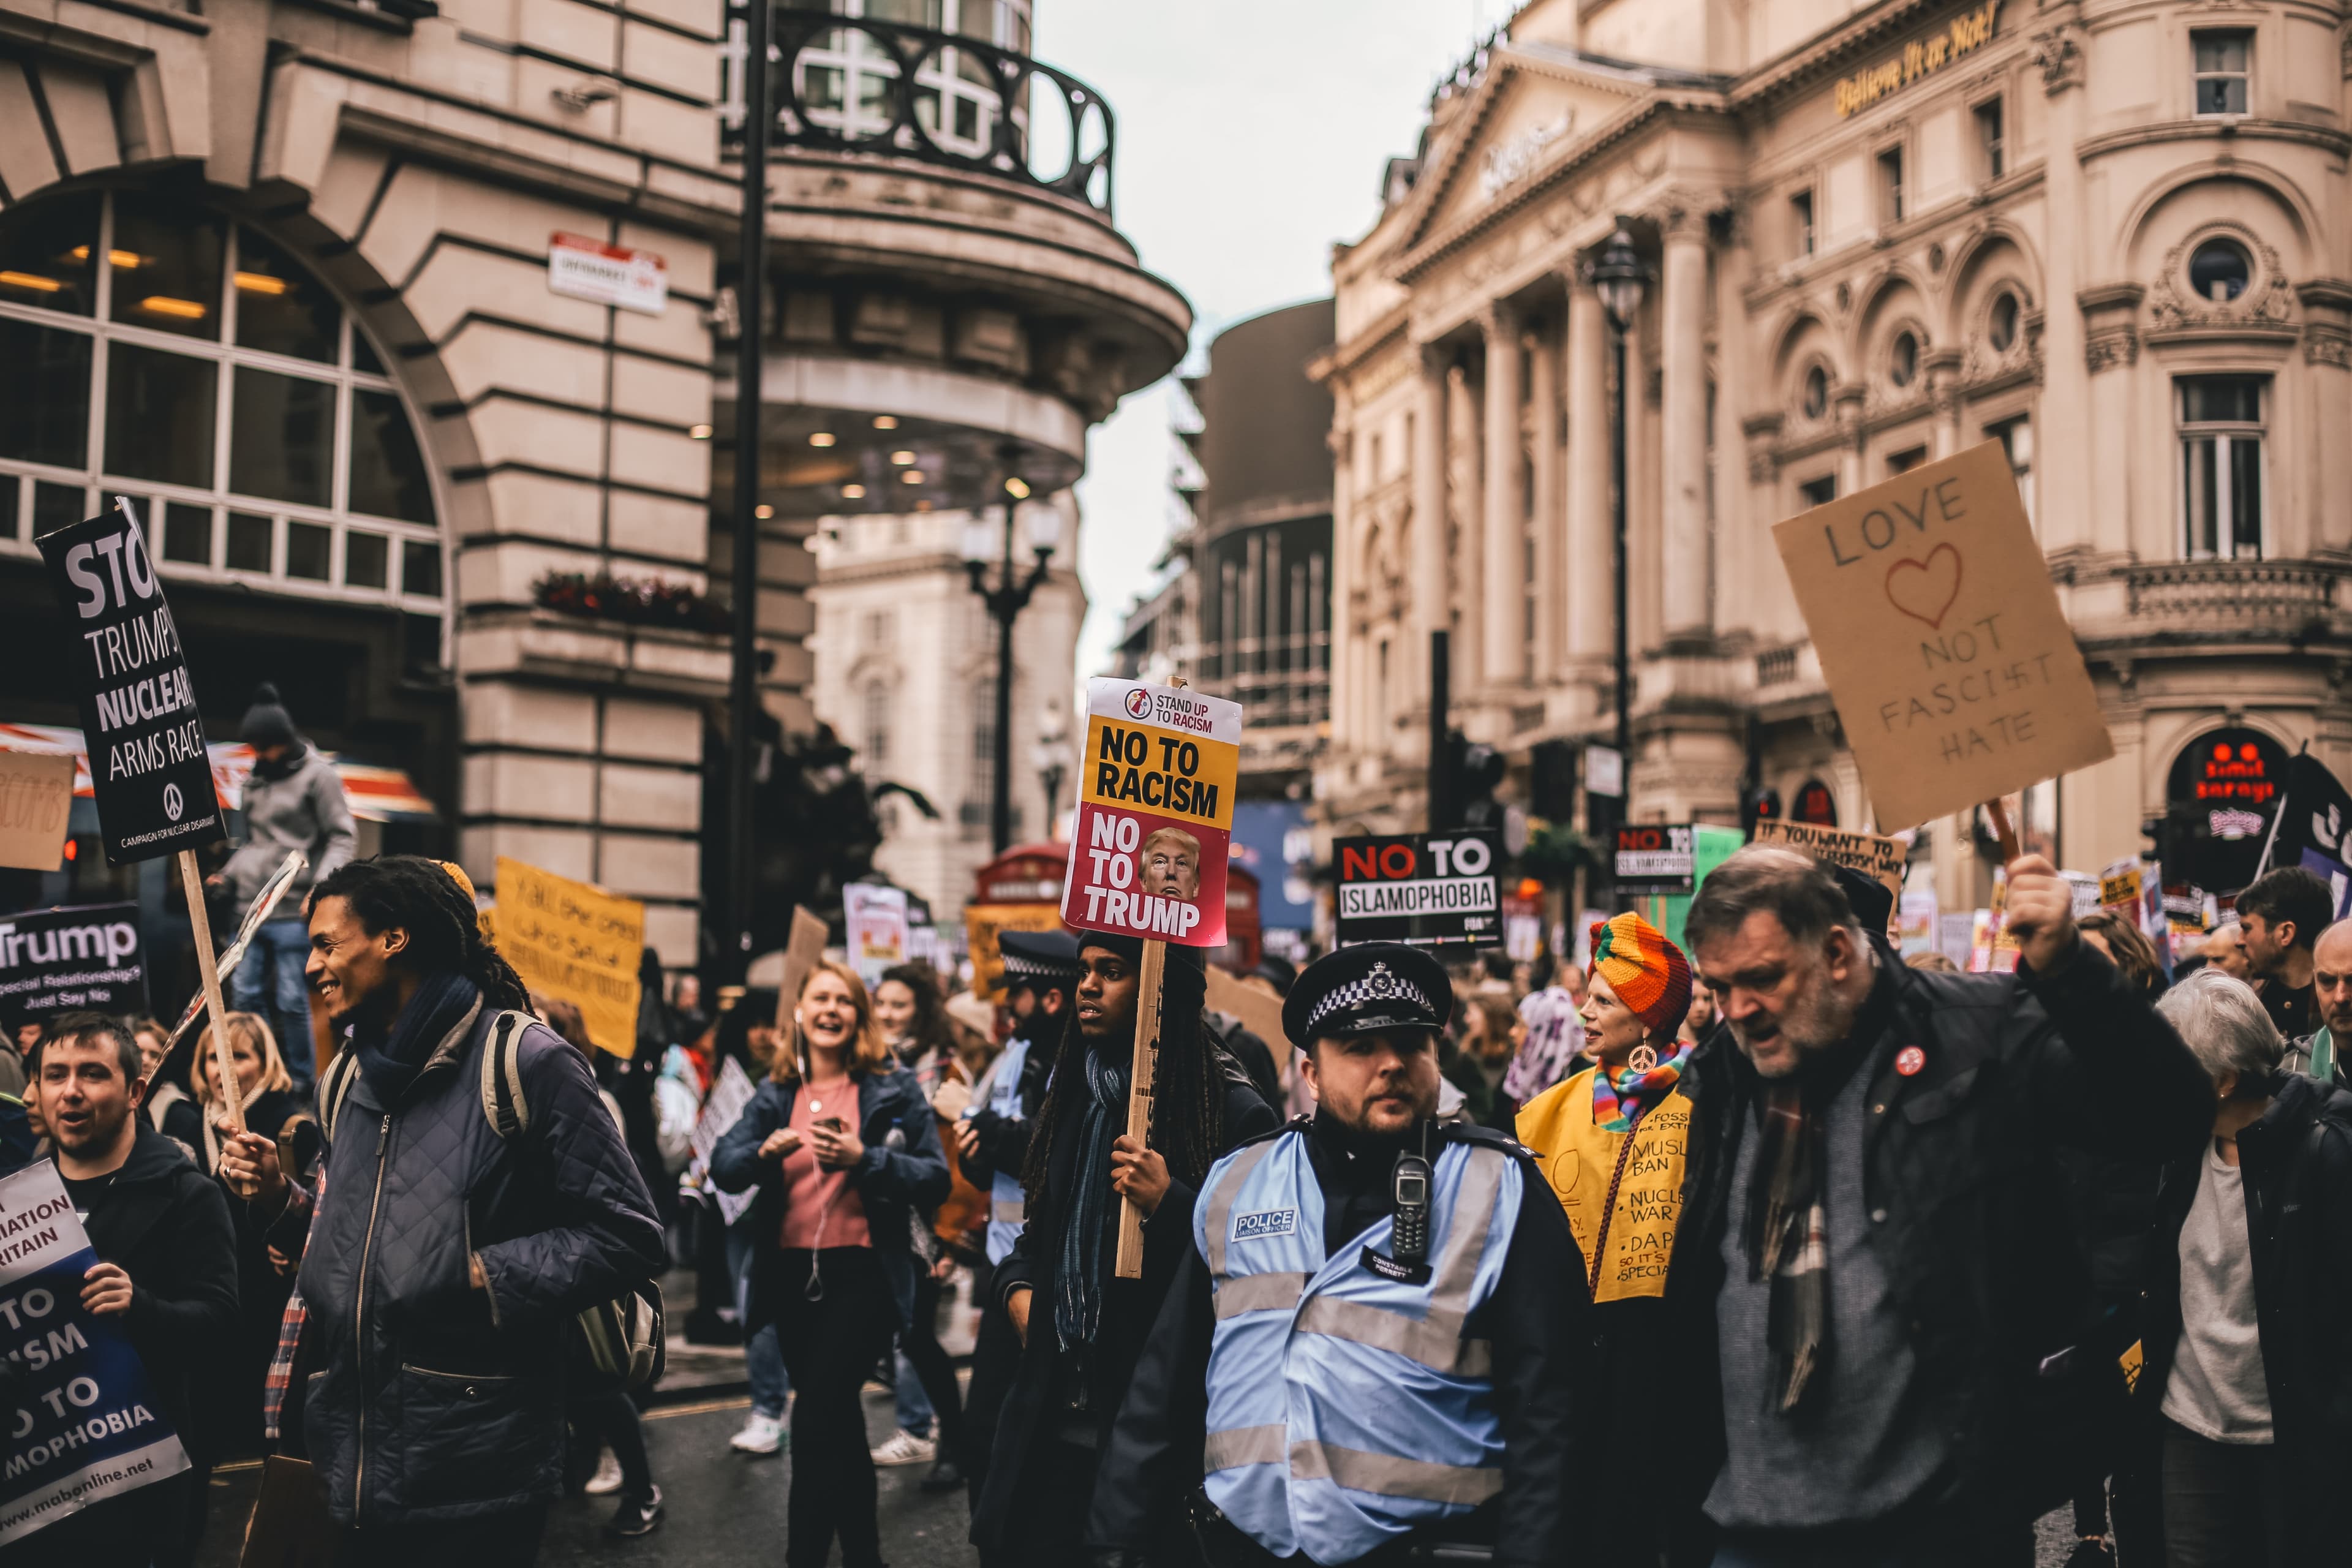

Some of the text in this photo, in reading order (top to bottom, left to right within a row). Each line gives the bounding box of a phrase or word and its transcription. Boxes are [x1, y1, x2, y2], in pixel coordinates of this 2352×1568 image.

[1825, 477, 1968, 567] LOVE
[1921, 614, 2004, 669] NOT
[1156, 695, 1208, 717] STAND UP
[1156, 709, 1213, 733] TO RACISM
[109, 720, 203, 782] ARMS RACE
[1099, 725, 1199, 777] NO TO
[1940, 711, 2037, 764] HATE
[1096, 762, 1218, 819] RACISM
[121, 833, 157, 848] CAMPAIGN
[157, 829, 168, 839] FOR
[168, 823, 190, 837] NUCLEAR
[1090, 812, 1140, 854] NO
[1618, 829, 1662, 850] NO
[1784, 826, 1815, 843] YOU
[1817, 831, 1864, 850] WANT
[1872, 840, 1893, 858] TO
[1088, 849, 1133, 890] TO
[1343, 838, 1491, 880] NO TO
[1084, 886, 1200, 937] TRUMP
[1342, 882, 1493, 913] ISLAMOPHOBIA
[0, 921, 137, 968] Trump
[58, 990, 86, 1006] Say
[1633, 1158, 1669, 1177] BAN
[1236, 1224, 1290, 1237] LIAISON OFFICER
[1238, 1212, 1293, 1231] POLICE
[1630, 1206, 1673, 1224] WAR
[1373, 1256, 1413, 1273] CONSTABLE
[1375, 1264, 1406, 1278] PERRETT
[1619, 1251, 1665, 1267] SO IT'S
[1, 1288, 55, 1330] TO
[41, 1377, 99, 1418] TO
